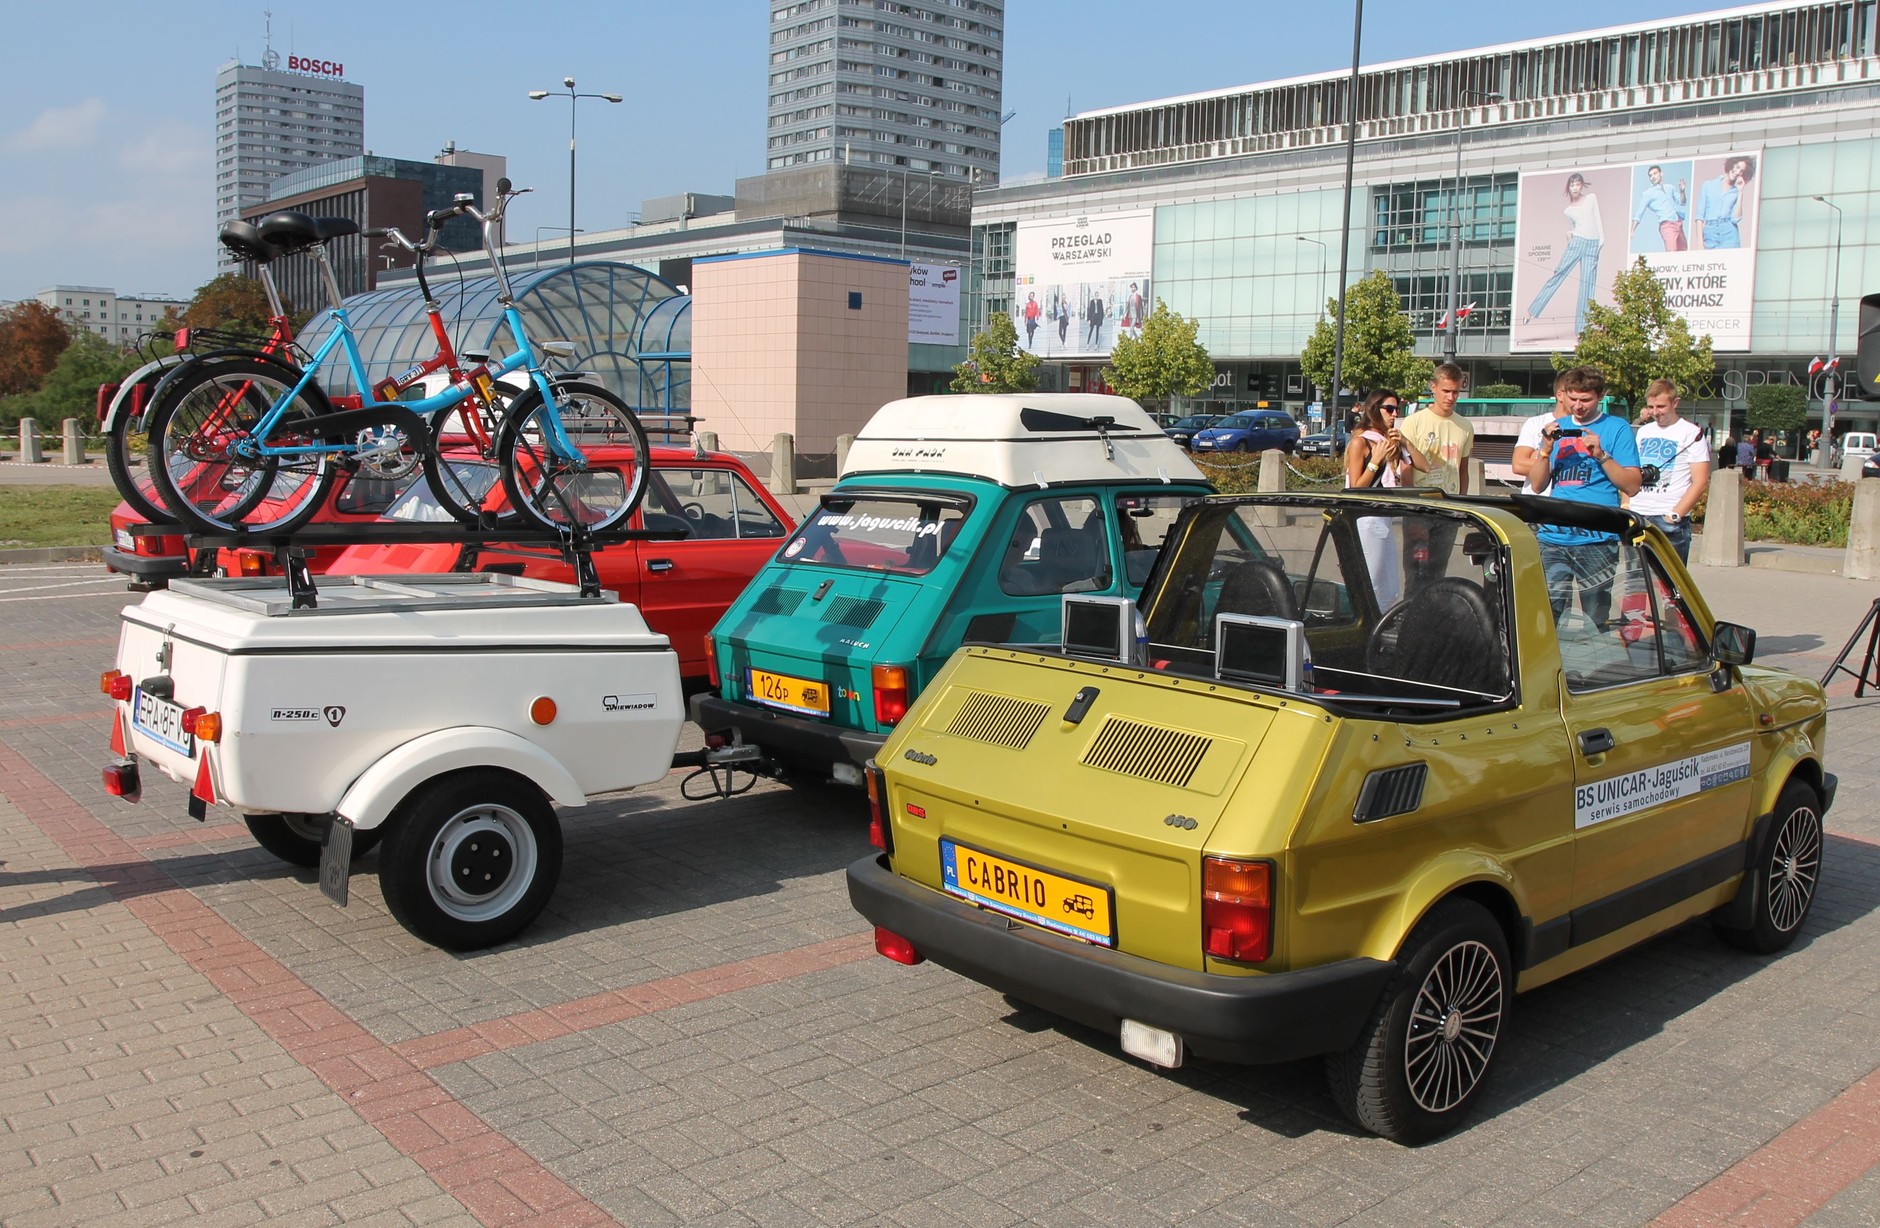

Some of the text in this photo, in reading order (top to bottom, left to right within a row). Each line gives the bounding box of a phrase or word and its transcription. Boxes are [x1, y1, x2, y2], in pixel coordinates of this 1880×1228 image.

[288, 55, 344, 77] BOSCH
[1051, 247, 1112, 261] WARSZAWSKI
[1652, 263, 1727, 273] NOWY, LETNI STYL
[1686, 272, 1727, 290] KTÓRE
[1687, 319, 1740, 330] SPENCER
[1640, 437, 1677, 459] 126
[817, 512, 946, 538] www.jaguscik.pl
[139, 693, 159, 732] ERA
[1576, 786, 1595, 811] BS
[1590, 786, 1681, 821] serwis samochodowy
[946, 865, 956, 878] PL
[966, 856, 1046, 908] CABRIO
